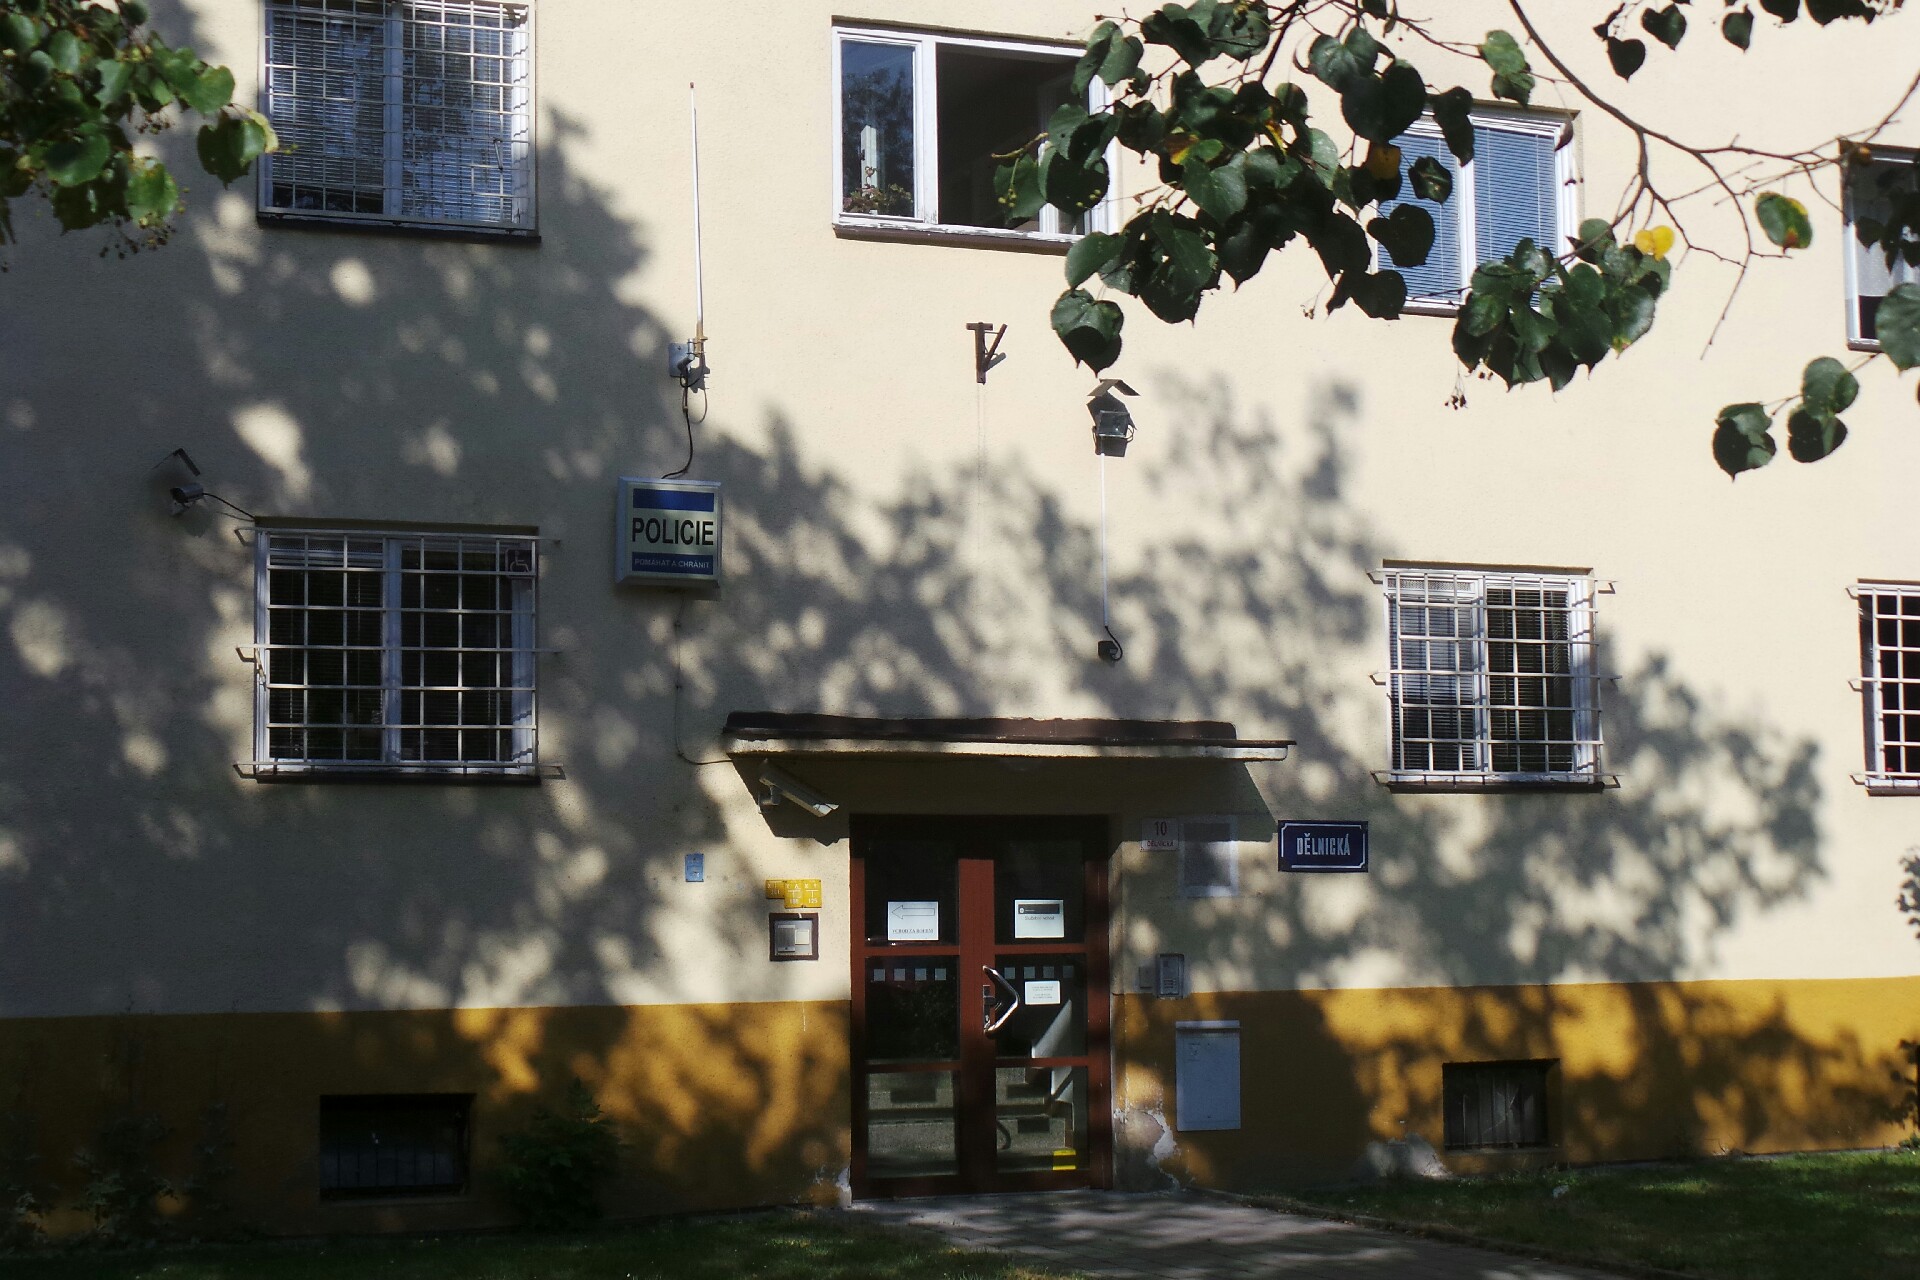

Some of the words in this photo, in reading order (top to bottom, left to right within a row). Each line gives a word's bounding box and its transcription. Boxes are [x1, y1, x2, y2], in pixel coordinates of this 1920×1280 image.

[632, 517, 714, 546] POLICIE
[1154, 820, 1168, 836] 10
[1296, 832, 1351, 856] DĚLNICKÁ
